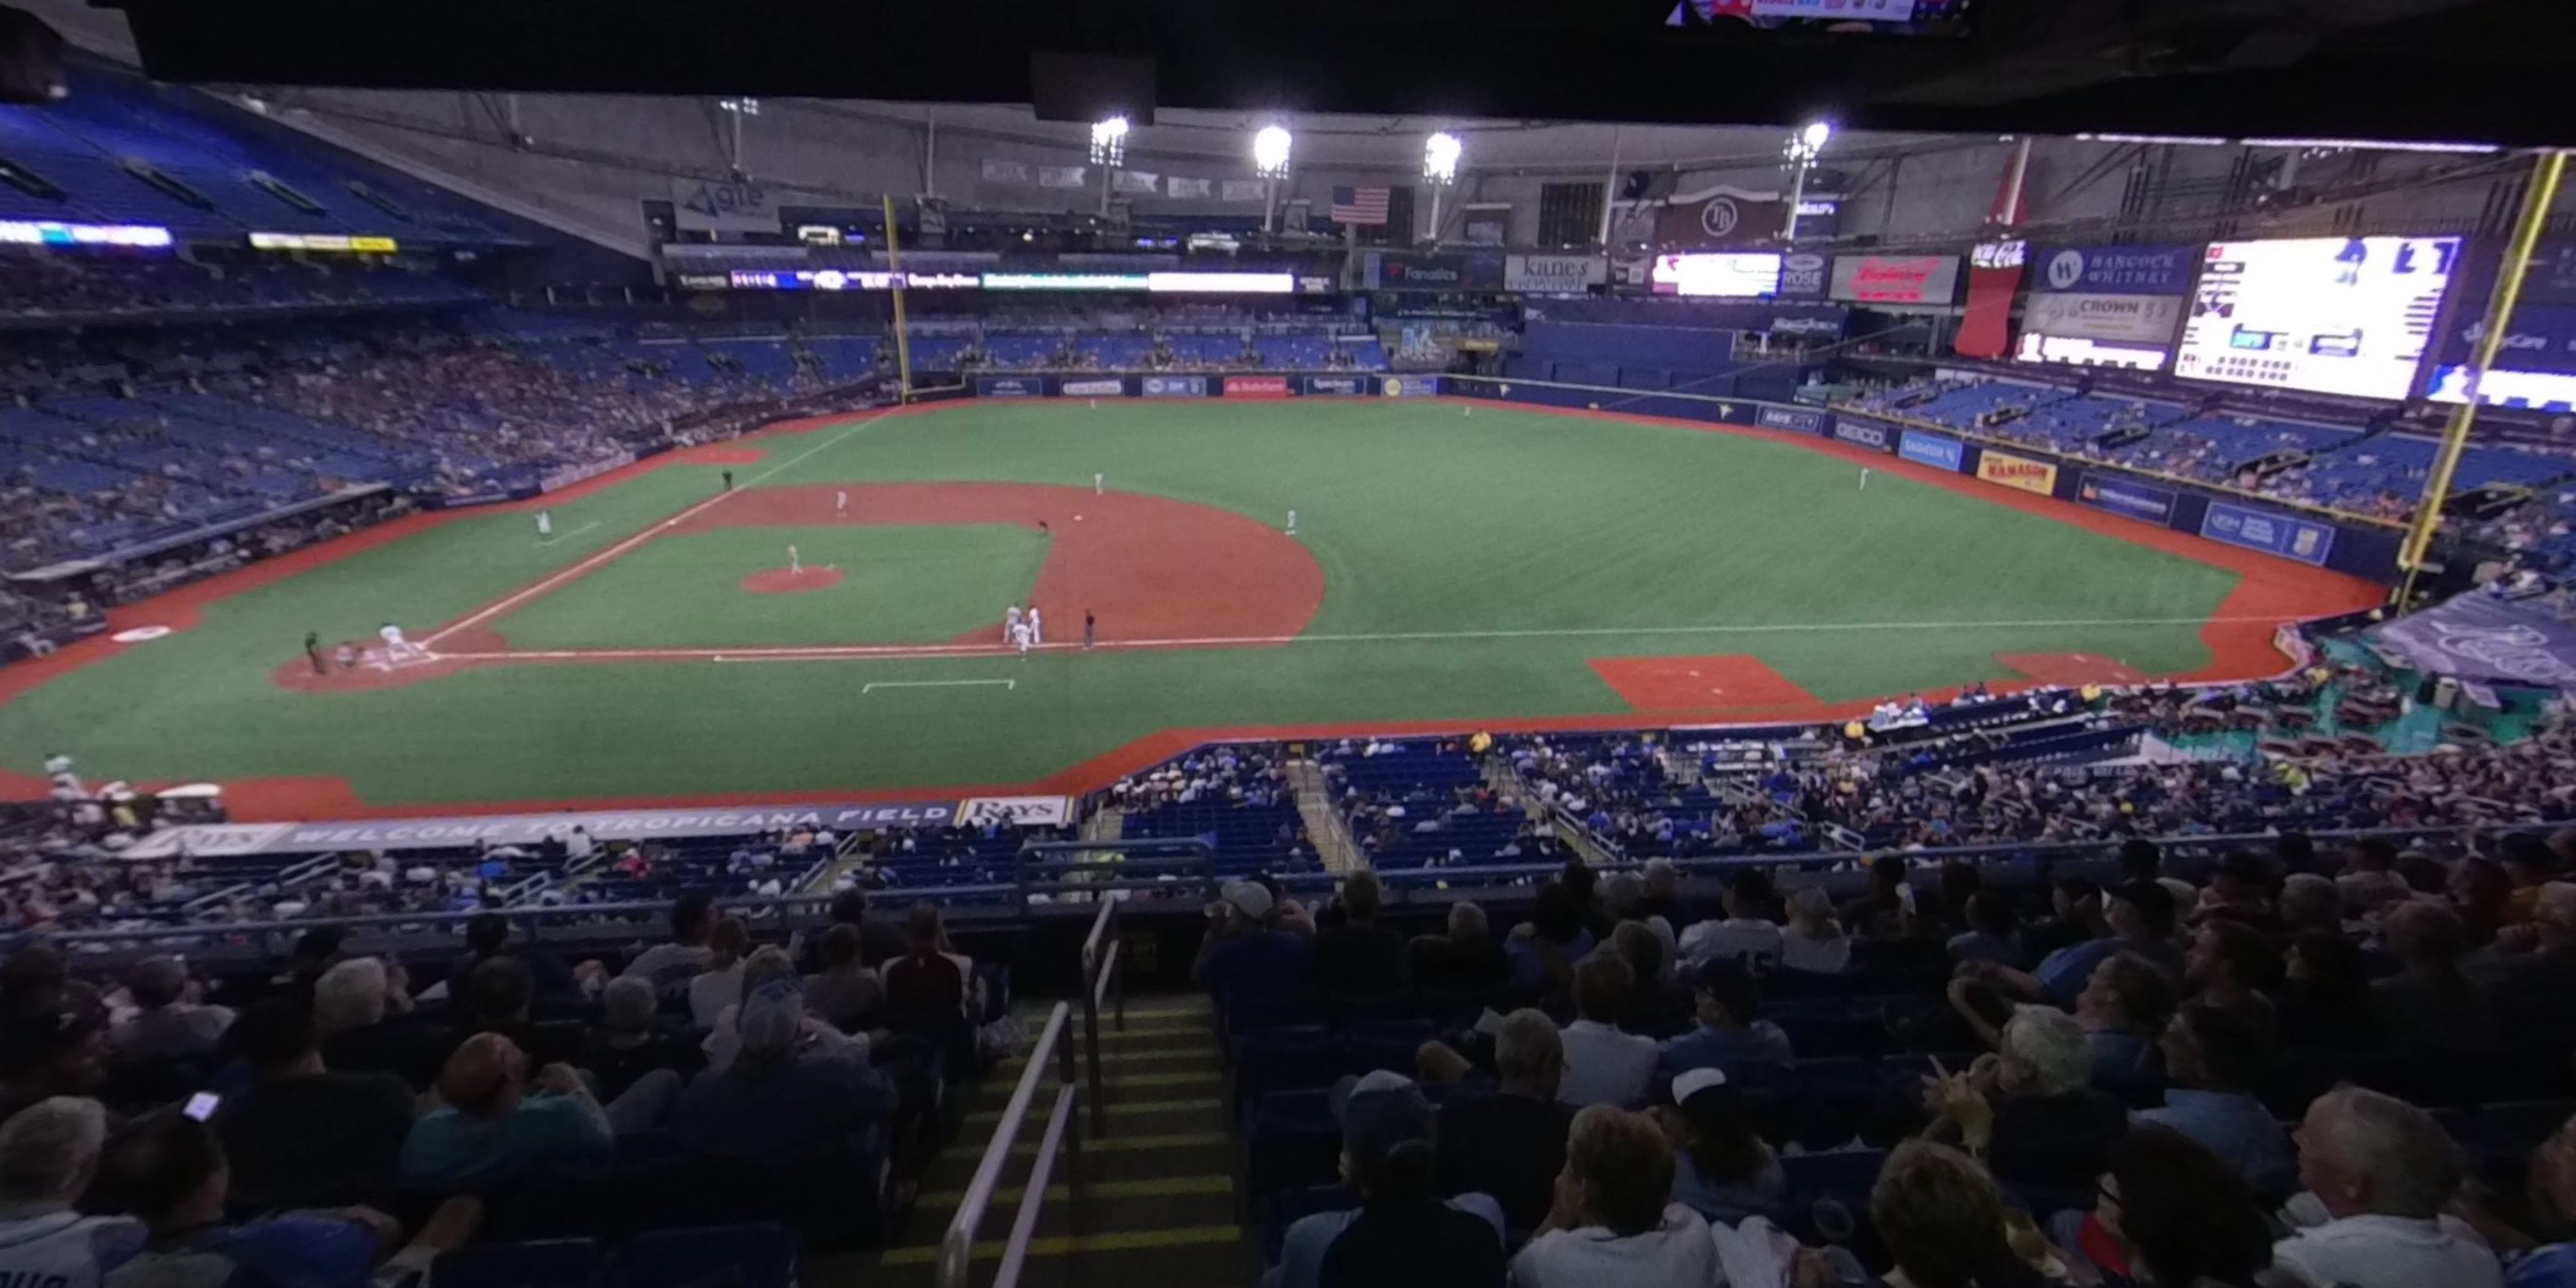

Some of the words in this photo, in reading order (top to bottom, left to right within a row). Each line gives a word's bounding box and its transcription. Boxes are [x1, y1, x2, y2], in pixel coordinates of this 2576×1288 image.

[2090, 255, 2175, 269] HANCOCK
[1404, 266, 1457, 281] Fanatics
[2088, 269, 2172, 284] WHITNEY
[2079, 299, 2140, 314] CROWN
[1835, 423, 1884, 446] GEICO
[974, 802, 1054, 820] RAYS
[293, 824, 510, 842] WELCOME
[525, 822, 576, 836] TO
[595, 812, 821, 832] TROPICANA
[836, 807, 948, 823] FIELD
